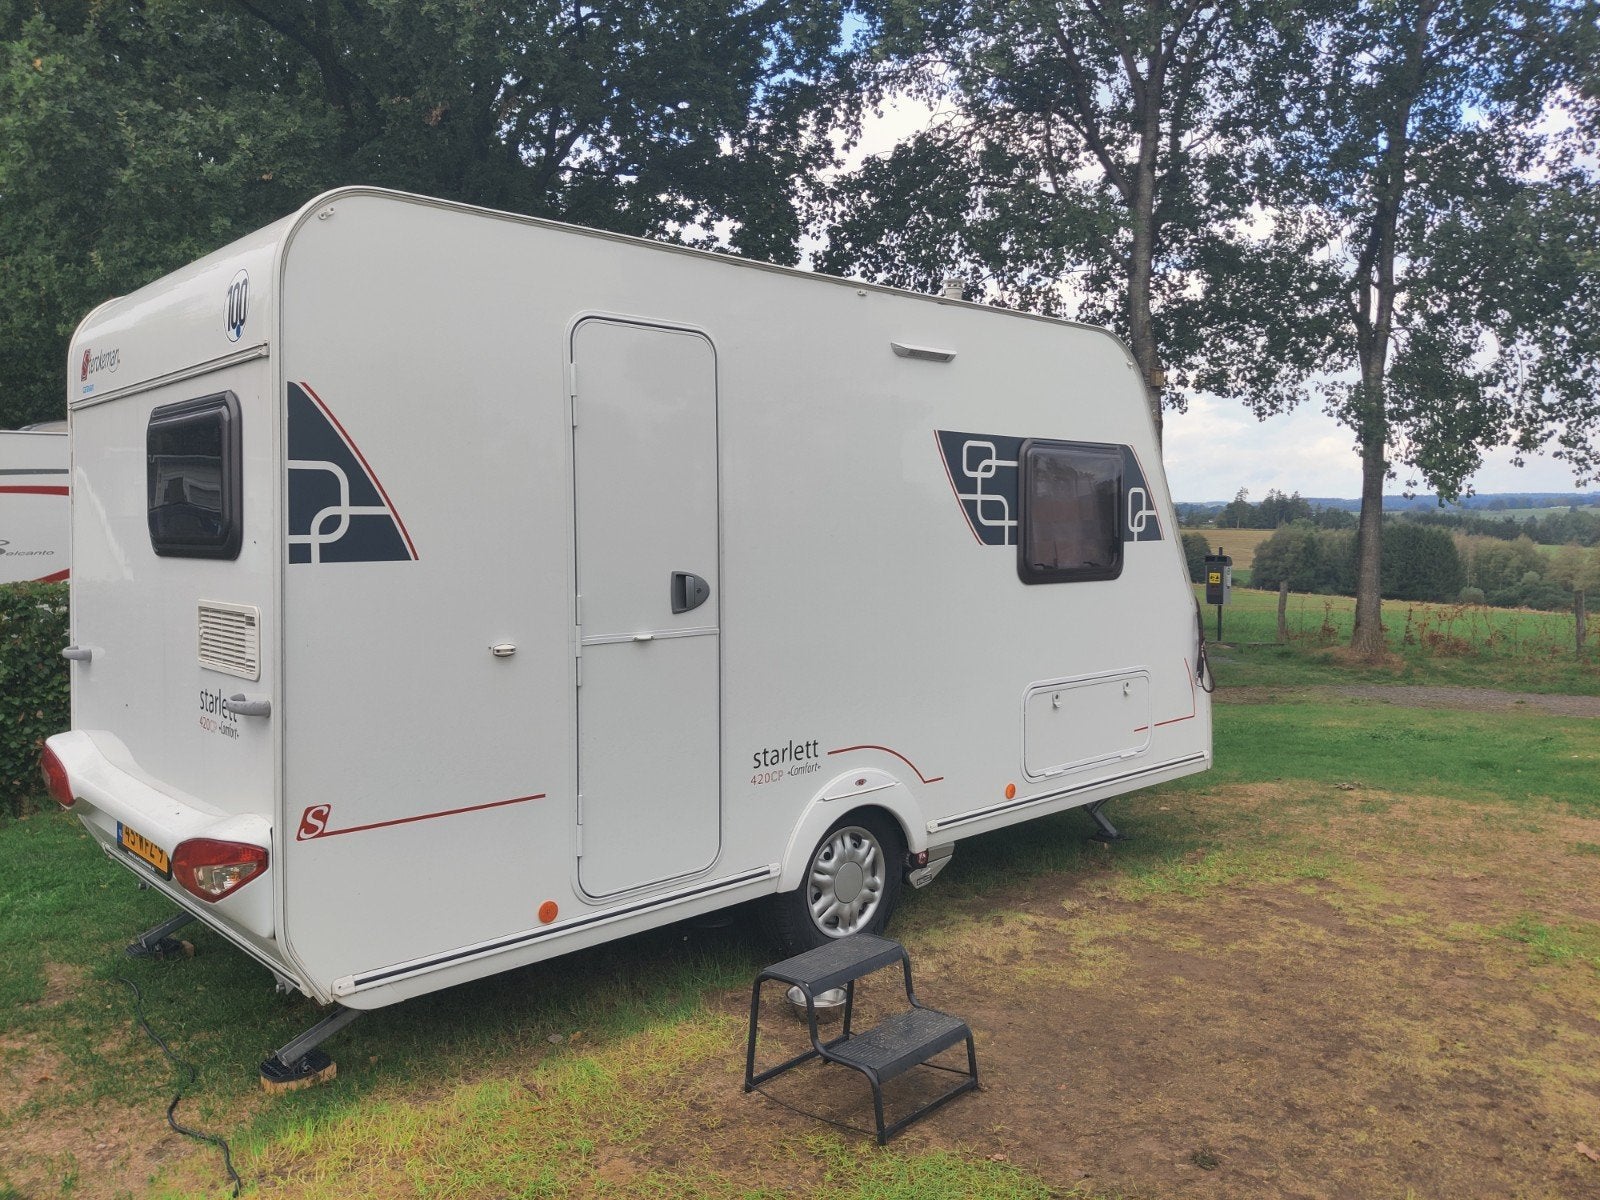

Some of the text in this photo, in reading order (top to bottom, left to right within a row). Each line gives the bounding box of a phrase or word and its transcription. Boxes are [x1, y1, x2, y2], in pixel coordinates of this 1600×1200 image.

[227, 278, 248, 332] 100
[753, 739, 819, 769] starlett
[750, 769, 784, 786] 420CP
